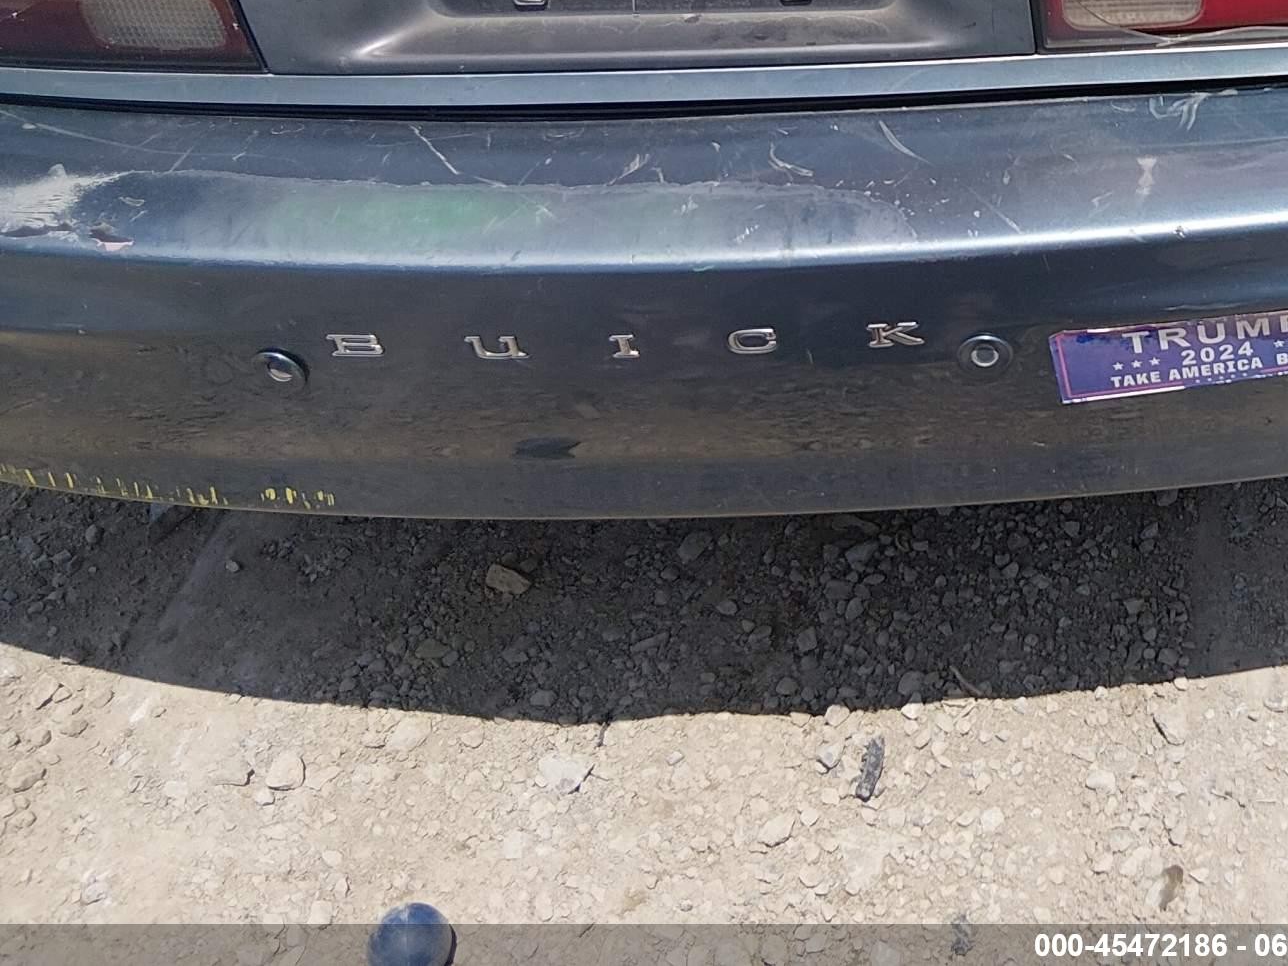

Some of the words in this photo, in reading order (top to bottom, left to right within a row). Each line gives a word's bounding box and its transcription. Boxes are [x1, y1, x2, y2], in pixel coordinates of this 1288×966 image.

[1180, 340, 1254, 366] 2024
[1110, 371, 1161, 388] TAKE
[1168, 356, 1263, 381] AMERICA
